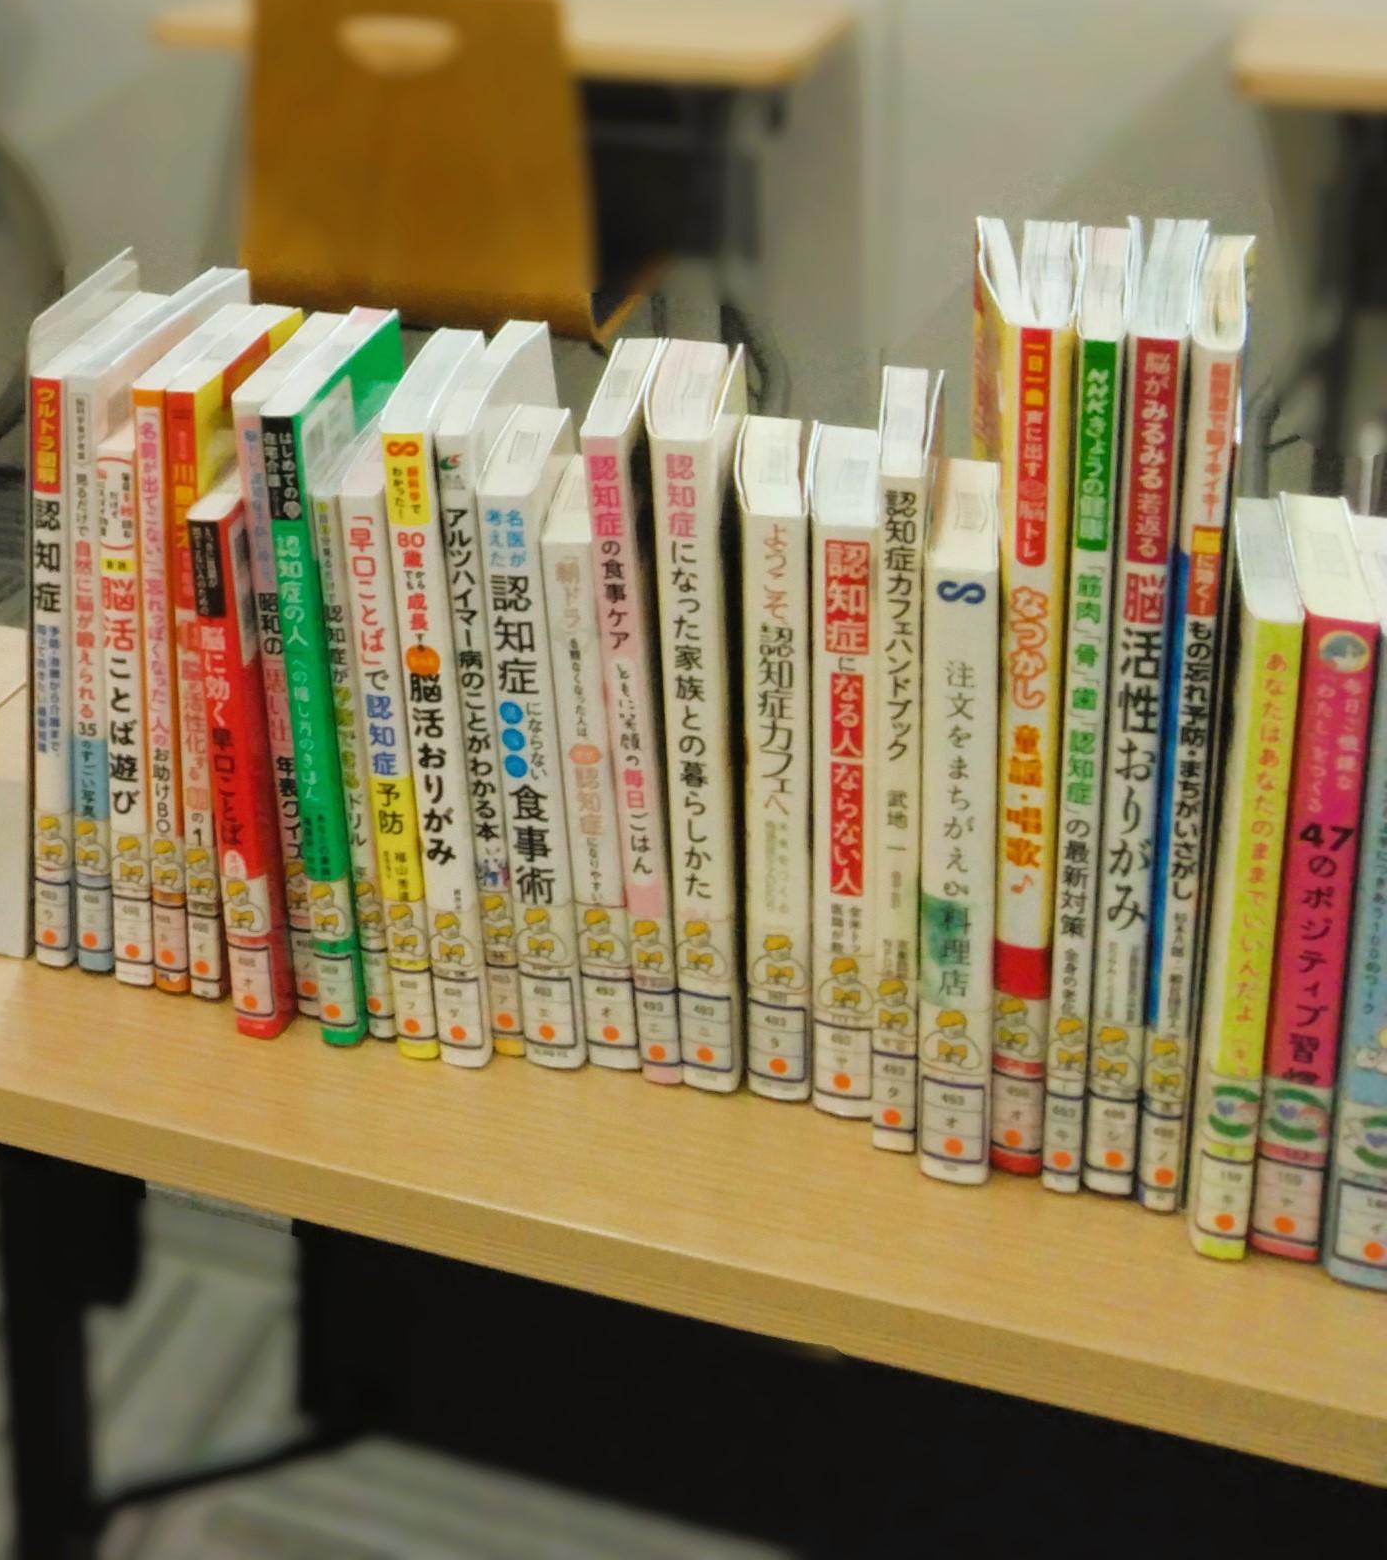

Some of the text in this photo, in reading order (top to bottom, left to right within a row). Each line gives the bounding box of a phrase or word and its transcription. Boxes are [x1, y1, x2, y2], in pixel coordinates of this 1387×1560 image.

[32, 498, 62, 615] 認知症
[485, 508, 527, 568] 考えた 名医が
[490, 574, 540, 696] 認知症
[589, 454, 631, 651] 認知症の食事ケア
[883, 490, 918, 762] 認知症カフェハンドブック
[99, 575, 141, 816] 脳活ことば遊び
[444, 506, 501, 843] アルツハイマー病のことがわかる本
[524, 700, 549, 781] にならない
[664, 452, 713, 900] 認知症になった家族との暮らしかた
[1009, 586, 1049, 710] なつかし
[409, 670, 458, 867] 脳活おりがみ
[509, 784, 557, 906] 食事術
[1108, 573, 1166, 932] 脳活性おりがみ
[1235, 652, 1289, 1023] あなたはあなたのままでいいんだよ
